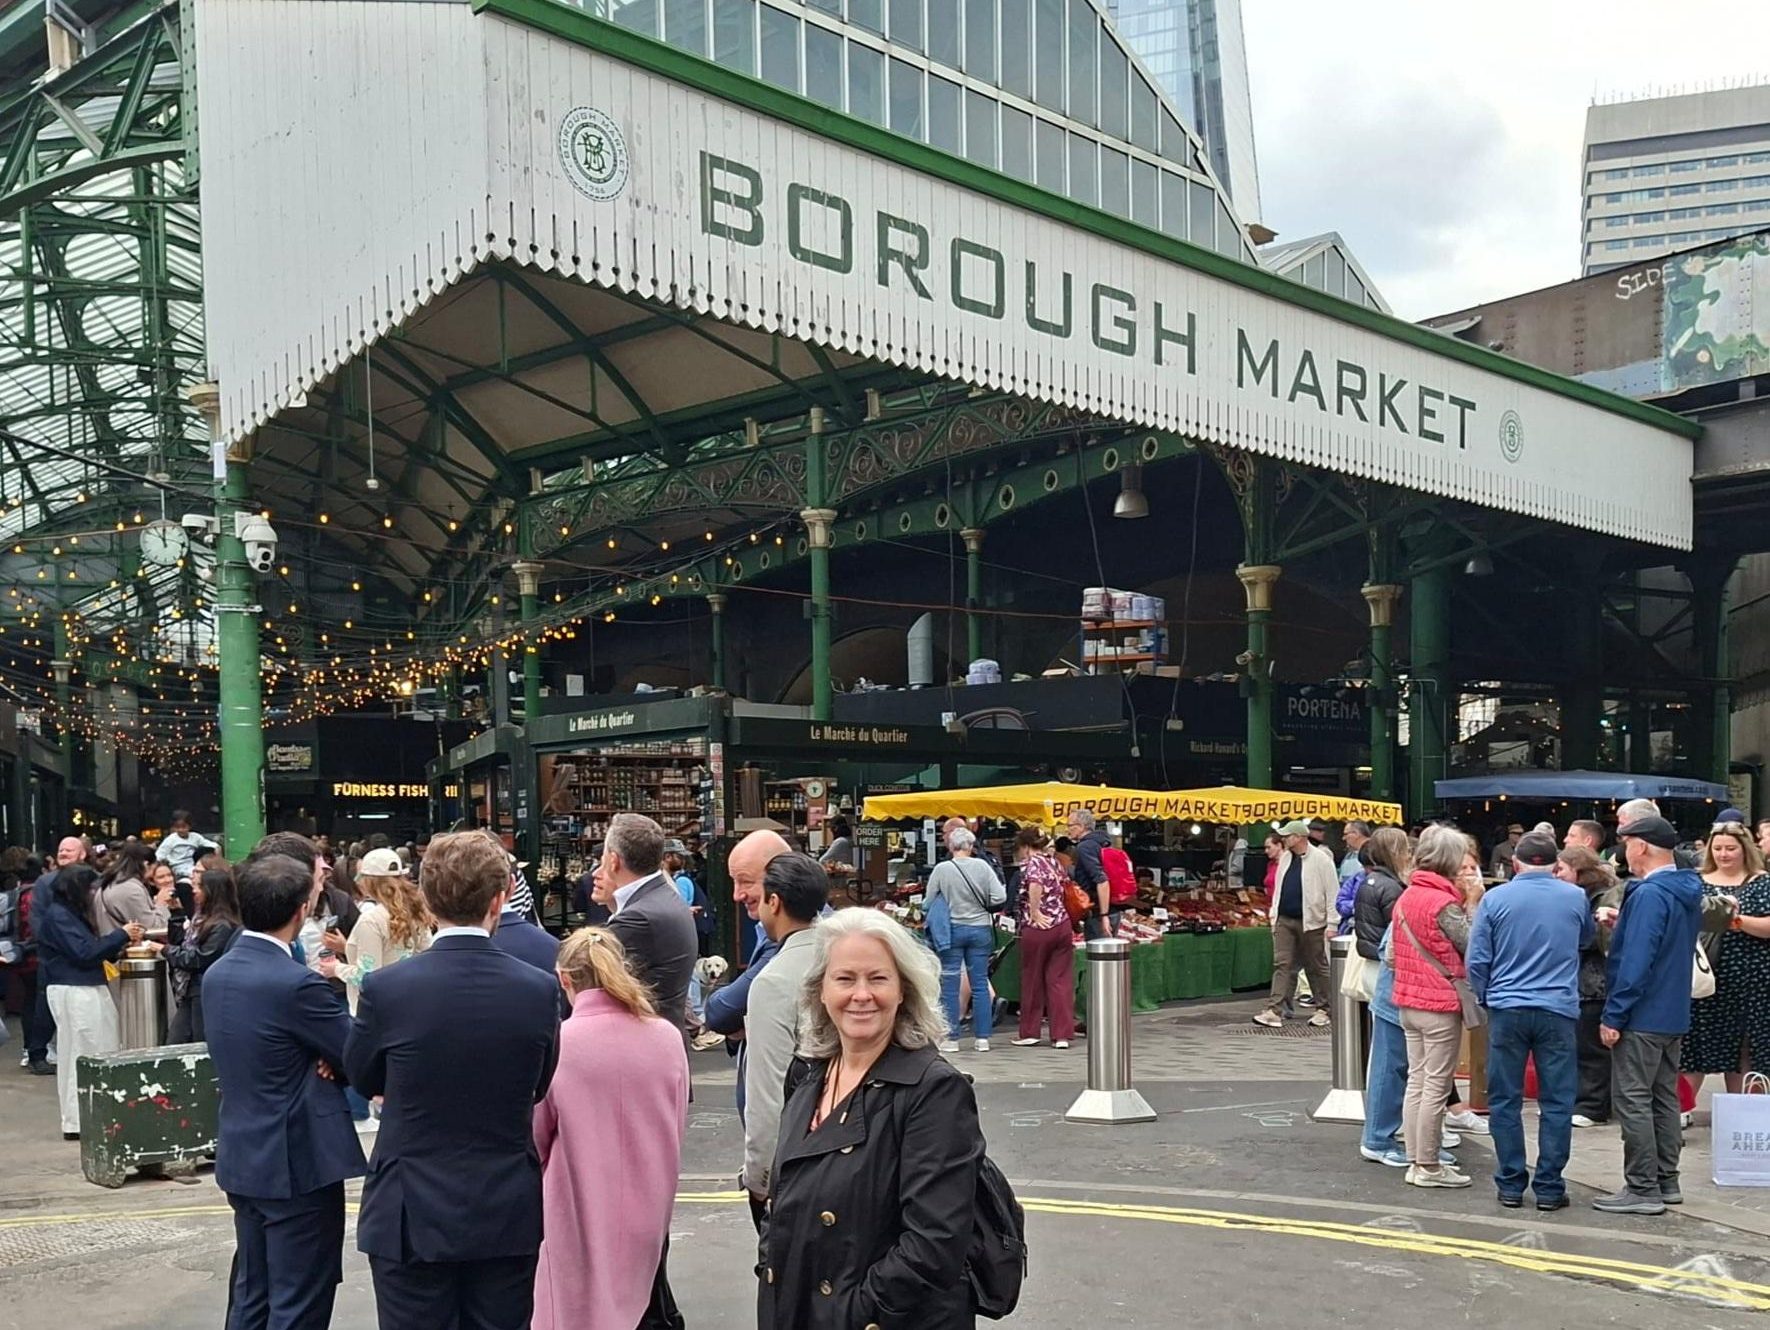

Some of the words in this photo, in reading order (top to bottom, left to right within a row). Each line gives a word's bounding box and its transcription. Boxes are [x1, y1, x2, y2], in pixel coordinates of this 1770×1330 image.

[563, 113, 596, 159] BOROUGH
[602, 120, 625, 175] MARKET
[1615, 262, 1677, 300] SIDE
[699, 149, 1197, 375] BOROUGH
[1237, 327, 1477, 449] MARKET
[569, 718, 576, 731] Le
[577, 714, 599, 730] Marché
[600, 714, 607, 728] du
[608, 711, 634, 729] Quartier
[810, 725, 821, 740] Le
[823, 726, 856, 741] Marché
[858, 727, 869, 742] du
[872, 728, 908, 744] Quartier
[399, 784, 429, 797] FISH
[1164, 799, 1242, 819] MARKET
[1337, 802, 1400, 819] MARKET
[856, 828, 882, 836] ORDER
[859, 837, 880, 845] HERE
